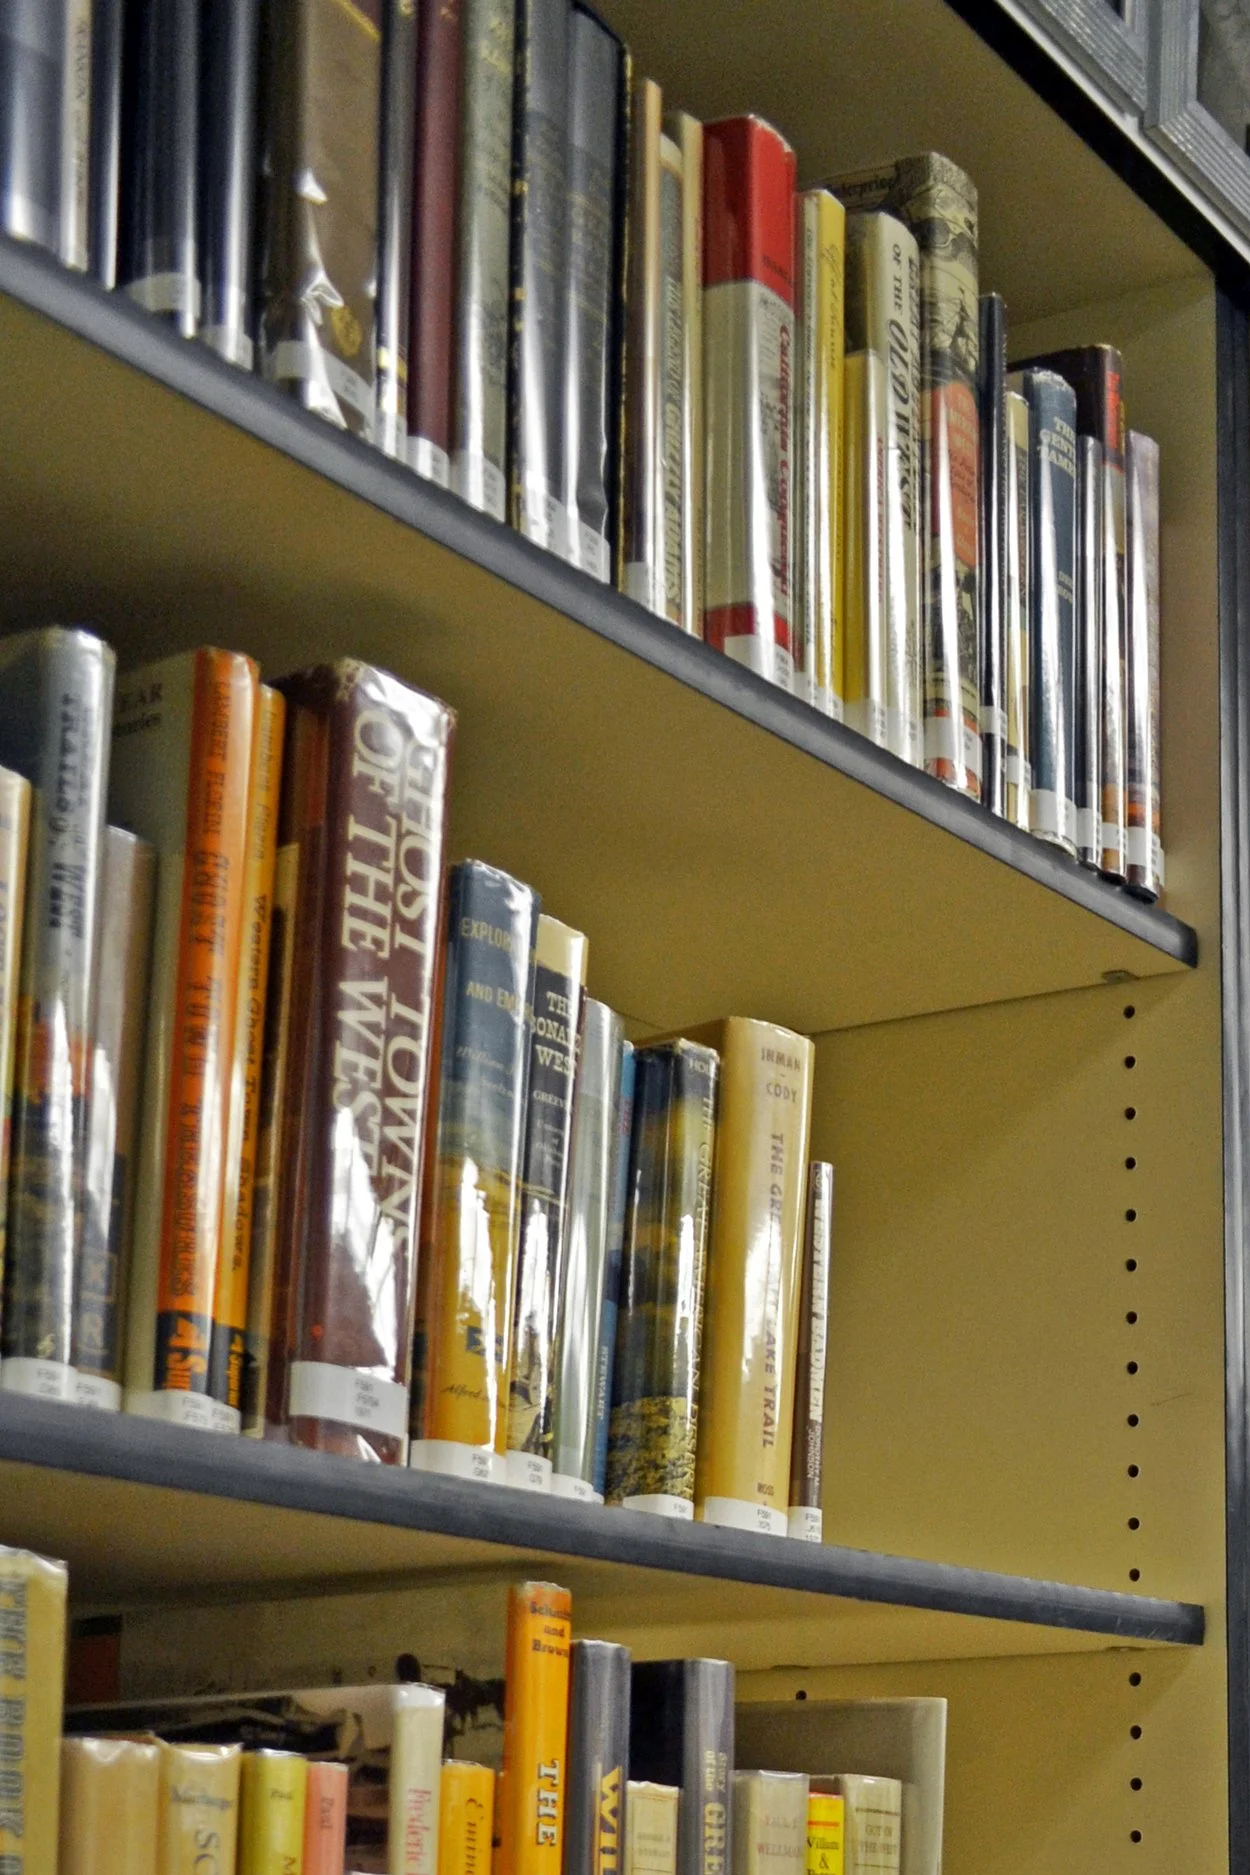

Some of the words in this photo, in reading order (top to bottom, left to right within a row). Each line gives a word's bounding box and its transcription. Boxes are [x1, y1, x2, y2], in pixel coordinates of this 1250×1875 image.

[208, 681, 230, 762] LAMBERT
[351, 709, 407, 803] OF
[203, 769, 225, 836] FLORIN
[393, 736, 445, 952] GHOST
[190, 851, 229, 954] GHOST
[344, 814, 398, 960] THE
[466, 980, 493, 1001] AND
[332, 974, 391, 1179] WEST
[534, 1043, 576, 1077] WEST
[760, 1047, 801, 1072] INMAN
[765, 1079, 798, 1104] CODY
[380, 997, 429, 1259] TOWNS
[806, 1426, 815, 1481] JOHNSON
[543, 1625, 566, 1638] and
[406, 1788, 432, 1868] Frederic
[536, 1758, 559, 1848] THE
[818, 1853, 828, 1868] &
